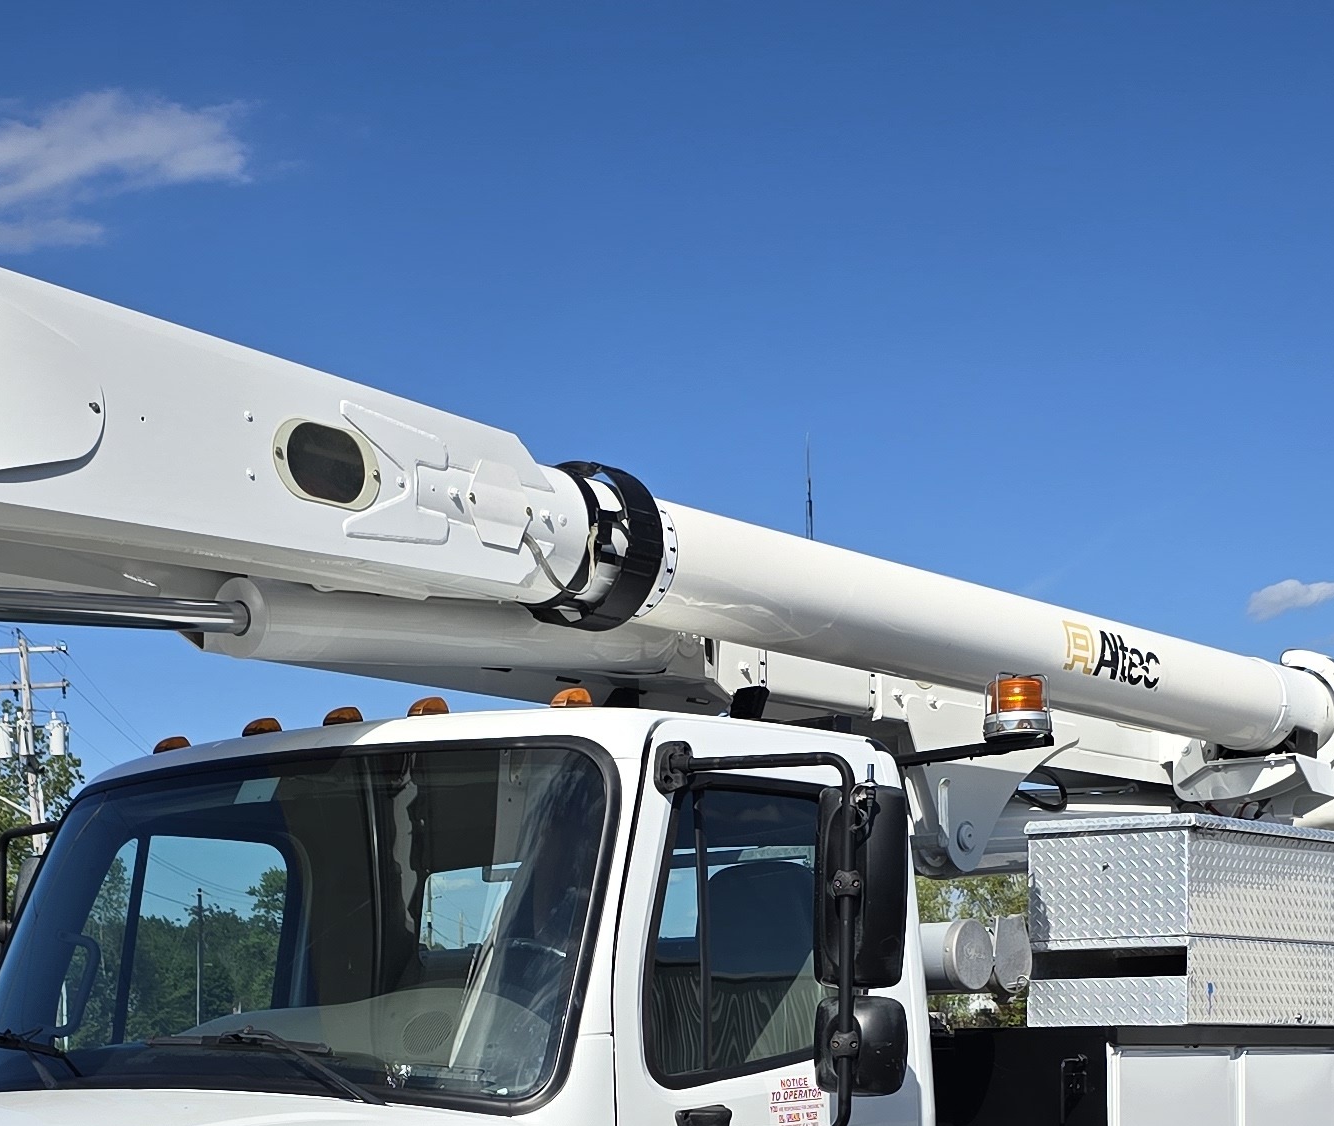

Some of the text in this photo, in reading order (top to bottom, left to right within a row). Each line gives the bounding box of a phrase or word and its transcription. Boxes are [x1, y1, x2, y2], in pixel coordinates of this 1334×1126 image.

[1092, 629, 1160, 689] Altec
[780, 1077, 808, 1088] NOTICE
[771, 1087, 822, 1101] TO OPERATOR
